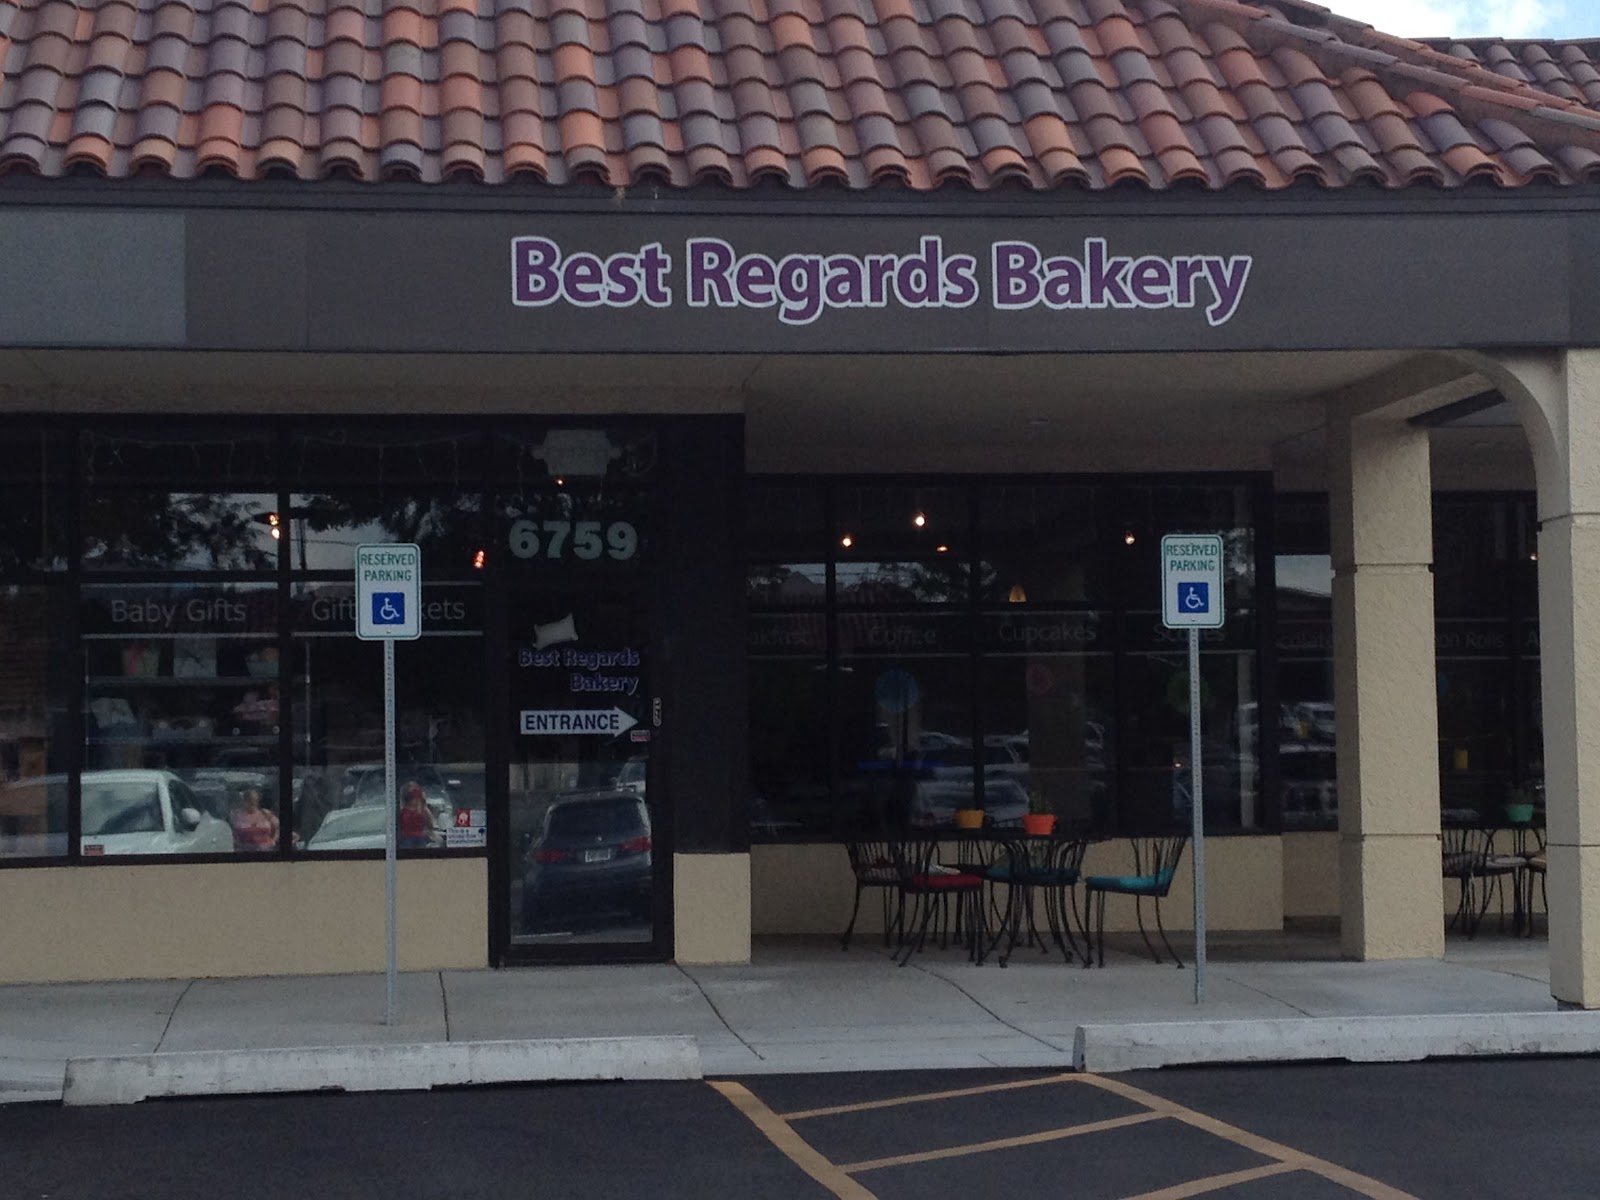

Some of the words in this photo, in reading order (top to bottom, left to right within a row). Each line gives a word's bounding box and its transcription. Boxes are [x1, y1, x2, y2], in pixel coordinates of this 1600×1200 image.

[511, 236, 672, 308] Best
[686, 237, 979, 326] Regards
[991, 237, 1250, 326] Bakery
[509, 520, 638, 560] 6759
[1166, 544, 1218, 556] RESERVED
[360, 553, 415, 566] RESERVED
[1170, 560, 1215, 571] PARKING
[364, 570, 411, 581] PARKING
[111, 598, 176, 629] Baby
[186, 598, 247, 622] Gifts
[998, 622, 1097, 648] Cupcakes
[519, 649, 560, 667] Best
[563, 648, 640, 671] Regards
[570, 673, 639, 696] Bakery
[525, 714, 619, 731] ENTRANCE
